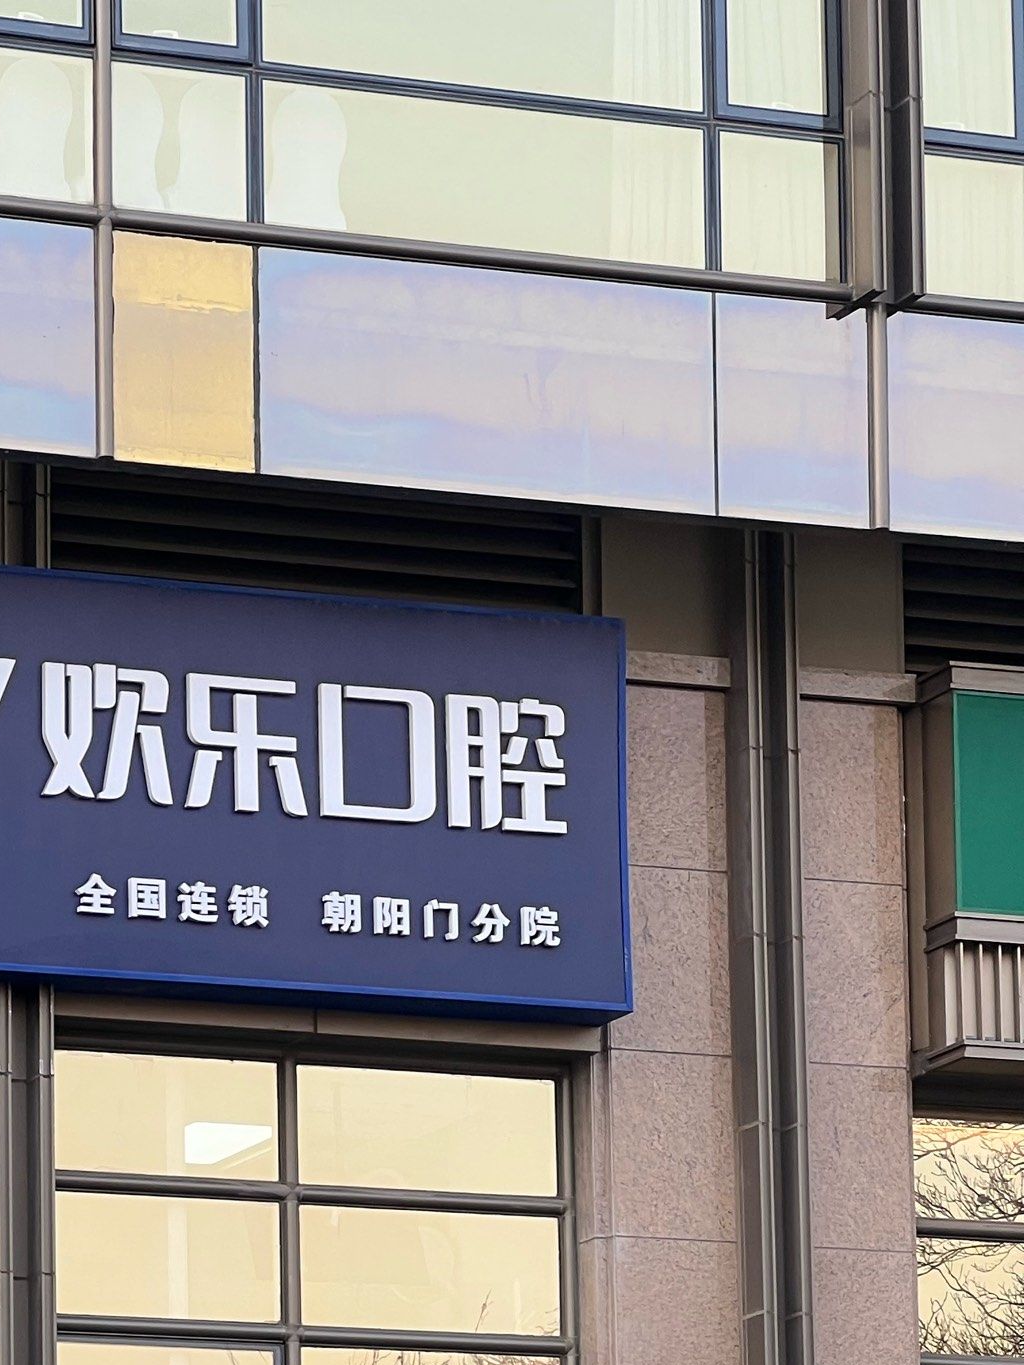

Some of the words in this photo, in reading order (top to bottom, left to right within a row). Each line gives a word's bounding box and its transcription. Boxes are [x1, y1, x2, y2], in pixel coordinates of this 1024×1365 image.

[40, 661, 568, 834] 欢乐口腔
[76, 872, 270, 928] 全国连锁
[321, 890, 561, 946] 朝阳门分院
